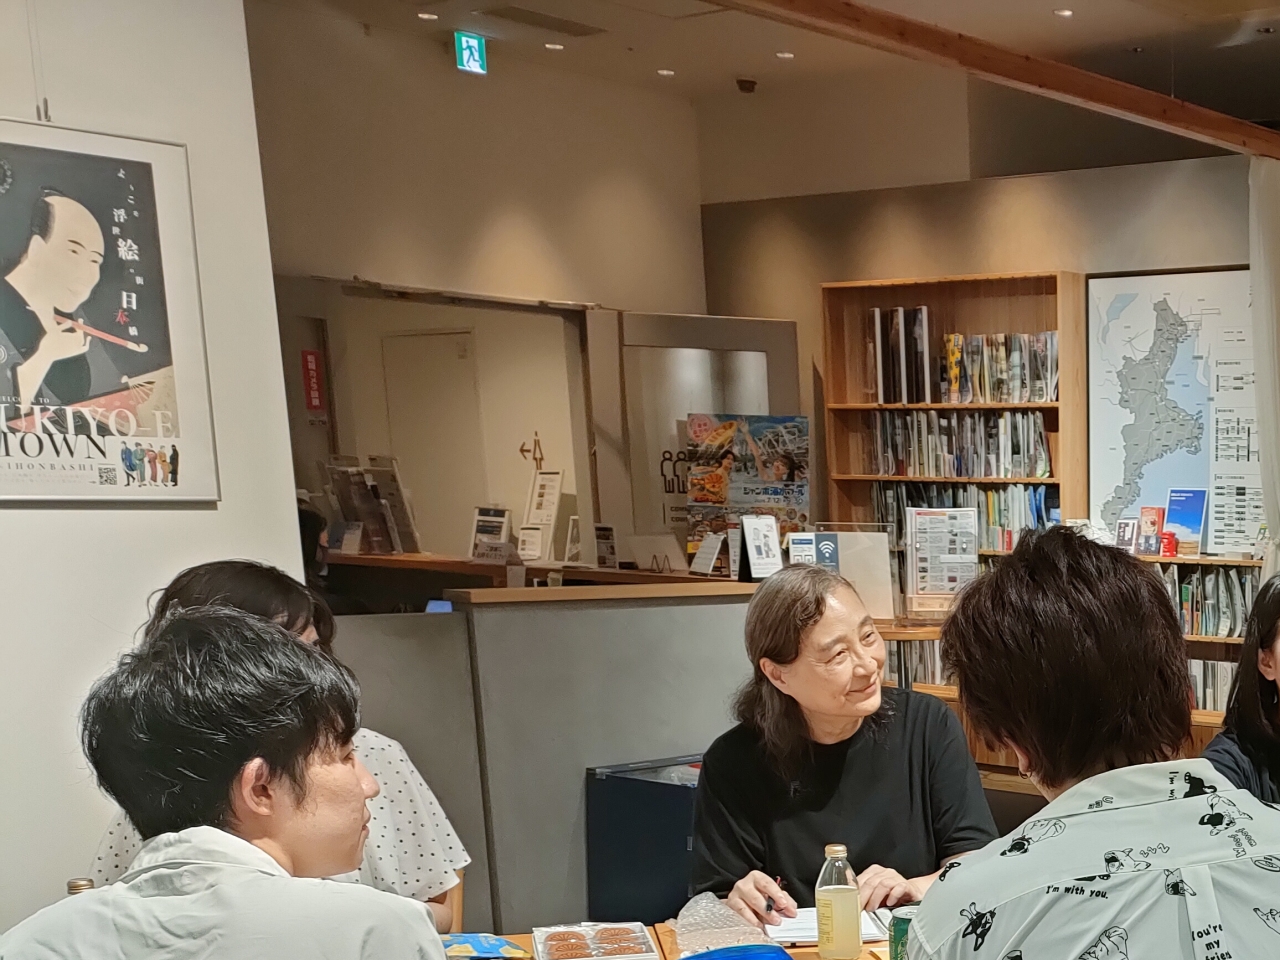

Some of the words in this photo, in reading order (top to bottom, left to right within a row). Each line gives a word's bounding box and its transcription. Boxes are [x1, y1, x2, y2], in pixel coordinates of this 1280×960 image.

[0, 432, 107, 459] TOWN
[1045, 884, 1060, 894] I'm
[1064, 885, 1085, 896] with
[1089, 887, 1109, 899] you.
[1205, 939, 1220, 951] my
